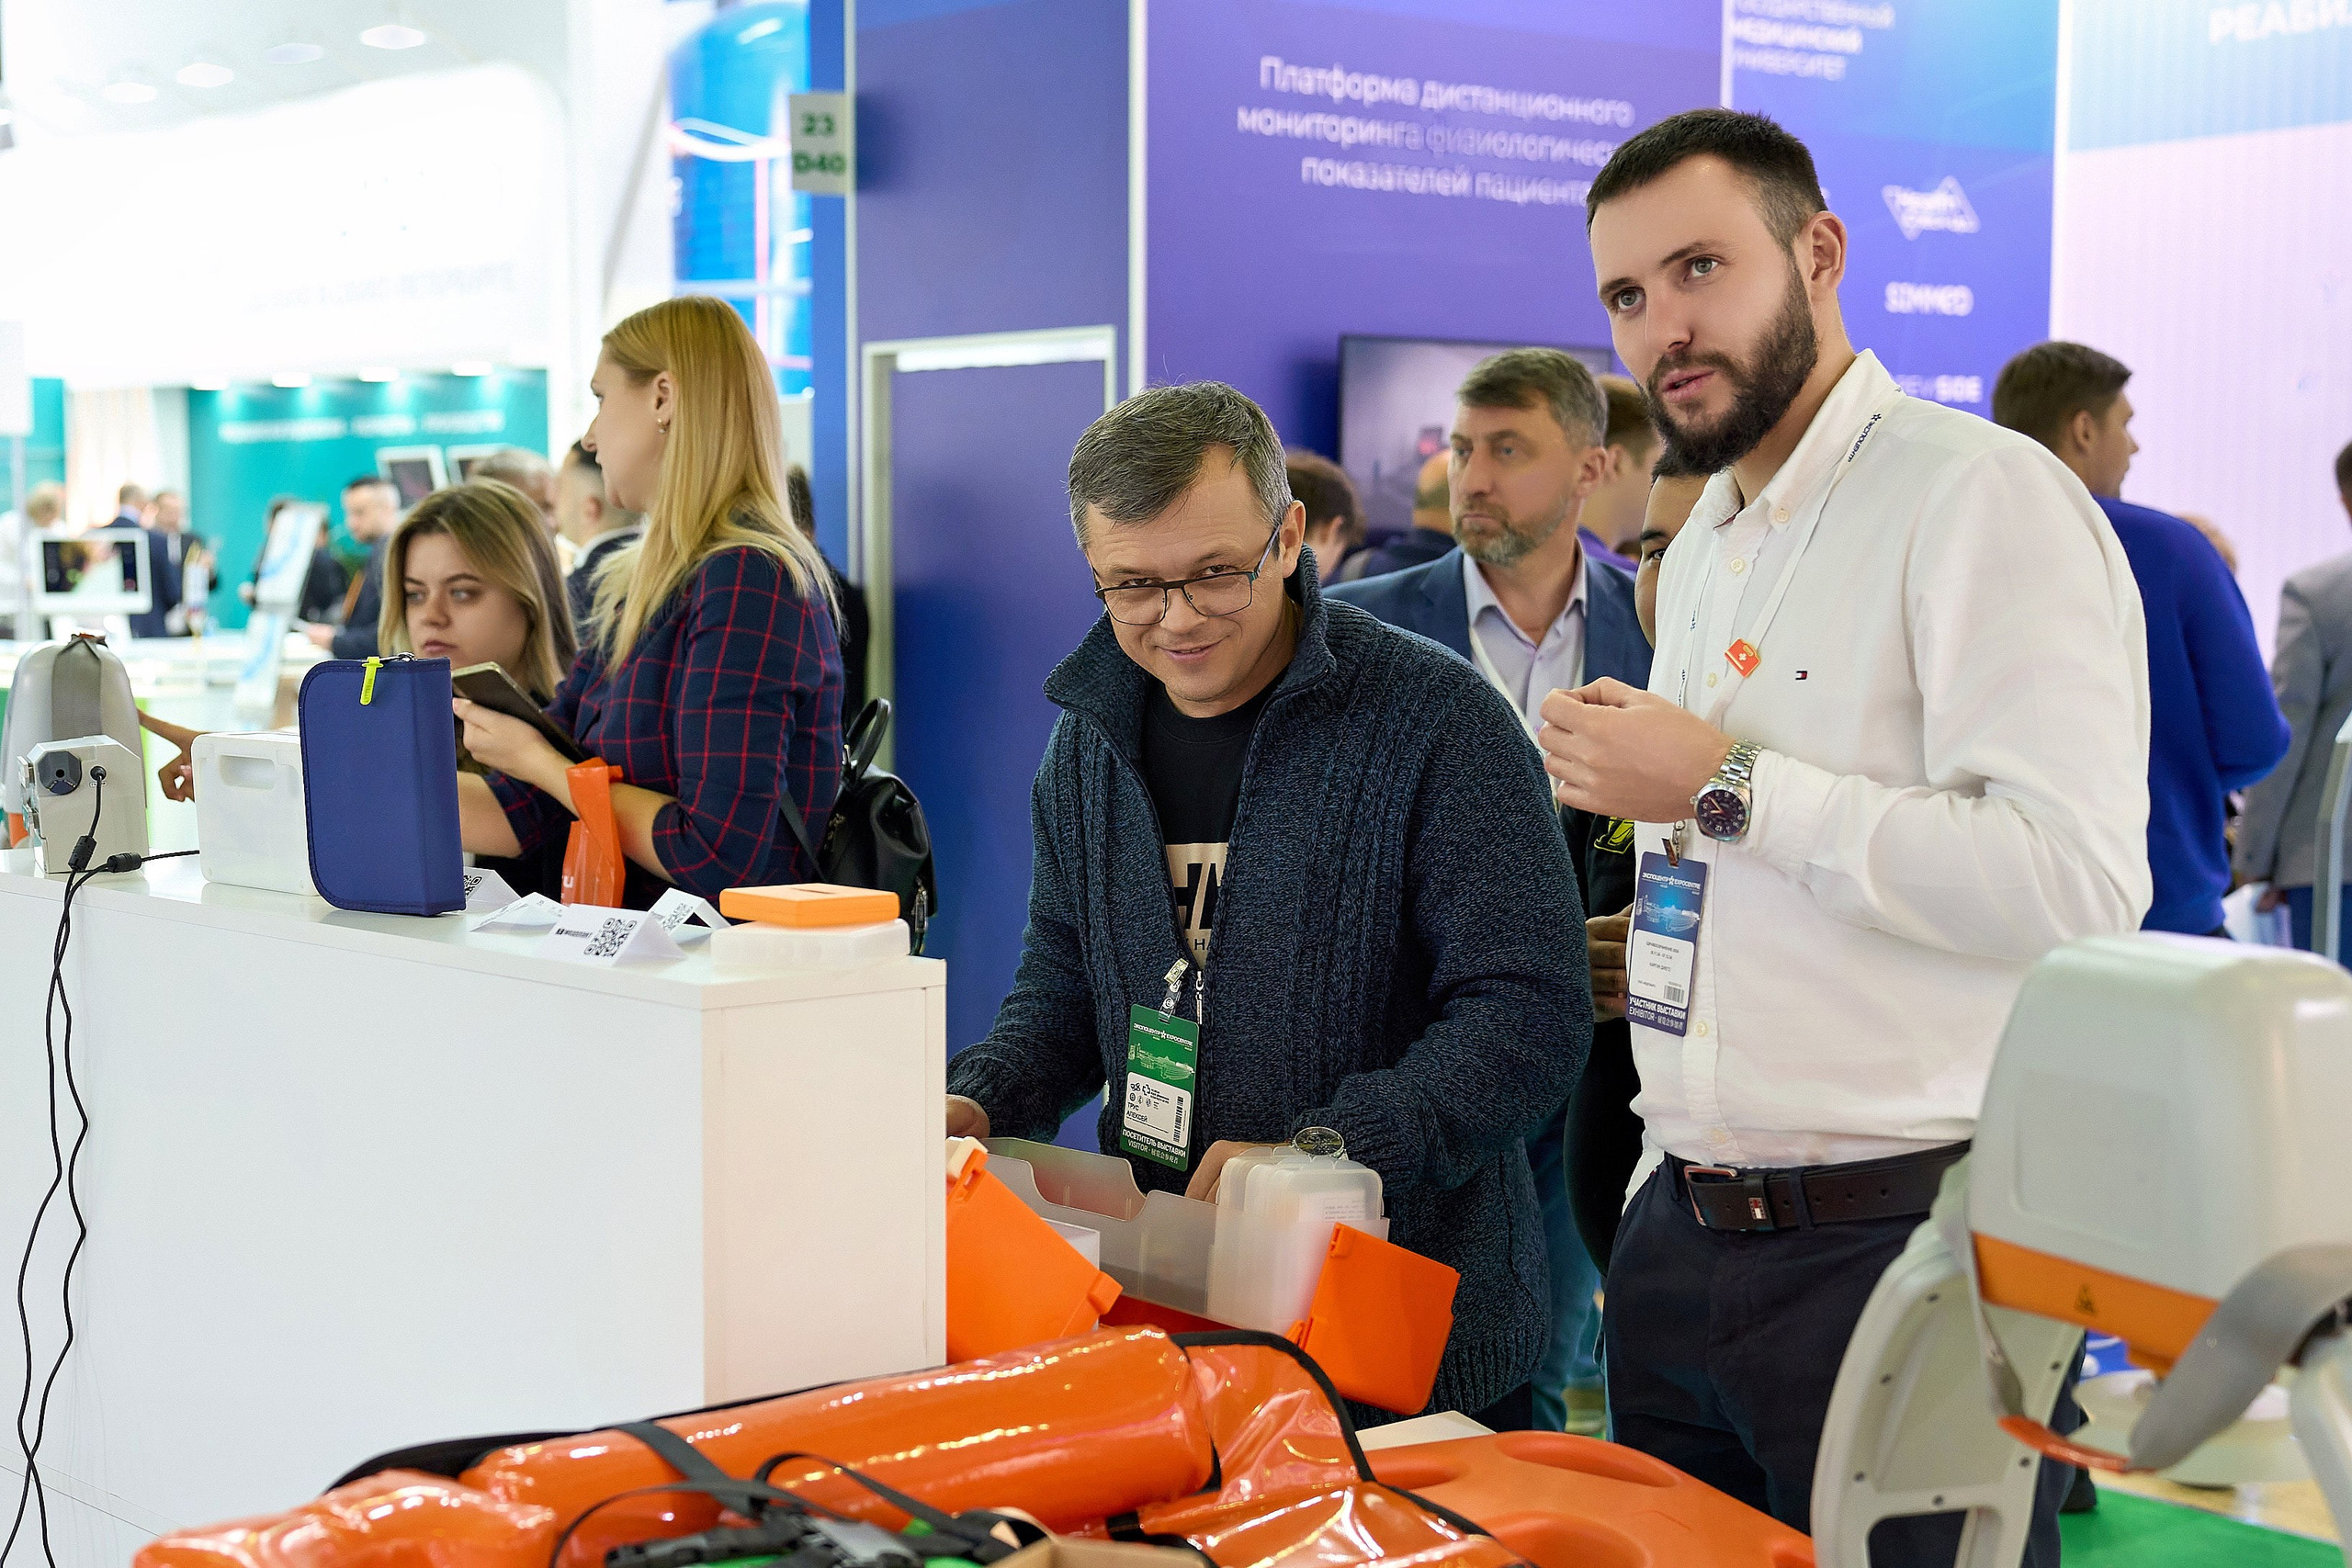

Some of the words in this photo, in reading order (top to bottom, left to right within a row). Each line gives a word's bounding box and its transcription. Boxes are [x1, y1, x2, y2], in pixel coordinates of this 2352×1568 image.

[2209, 0, 2352, 45] РЕАБИ
[1260, 55, 1418, 107] Платформа
[1420, 79, 1635, 129] дистанционного
[801, 111, 836, 138] 23
[1238, 105, 1423, 151] мониторинга
[1123, 1129, 1157, 1147] ПОСЕТИТЕЛЬ
[1157, 1140, 1187, 1158] ВЫСТАВКИ
[1128, 1139, 1148, 1153] VISITOR
